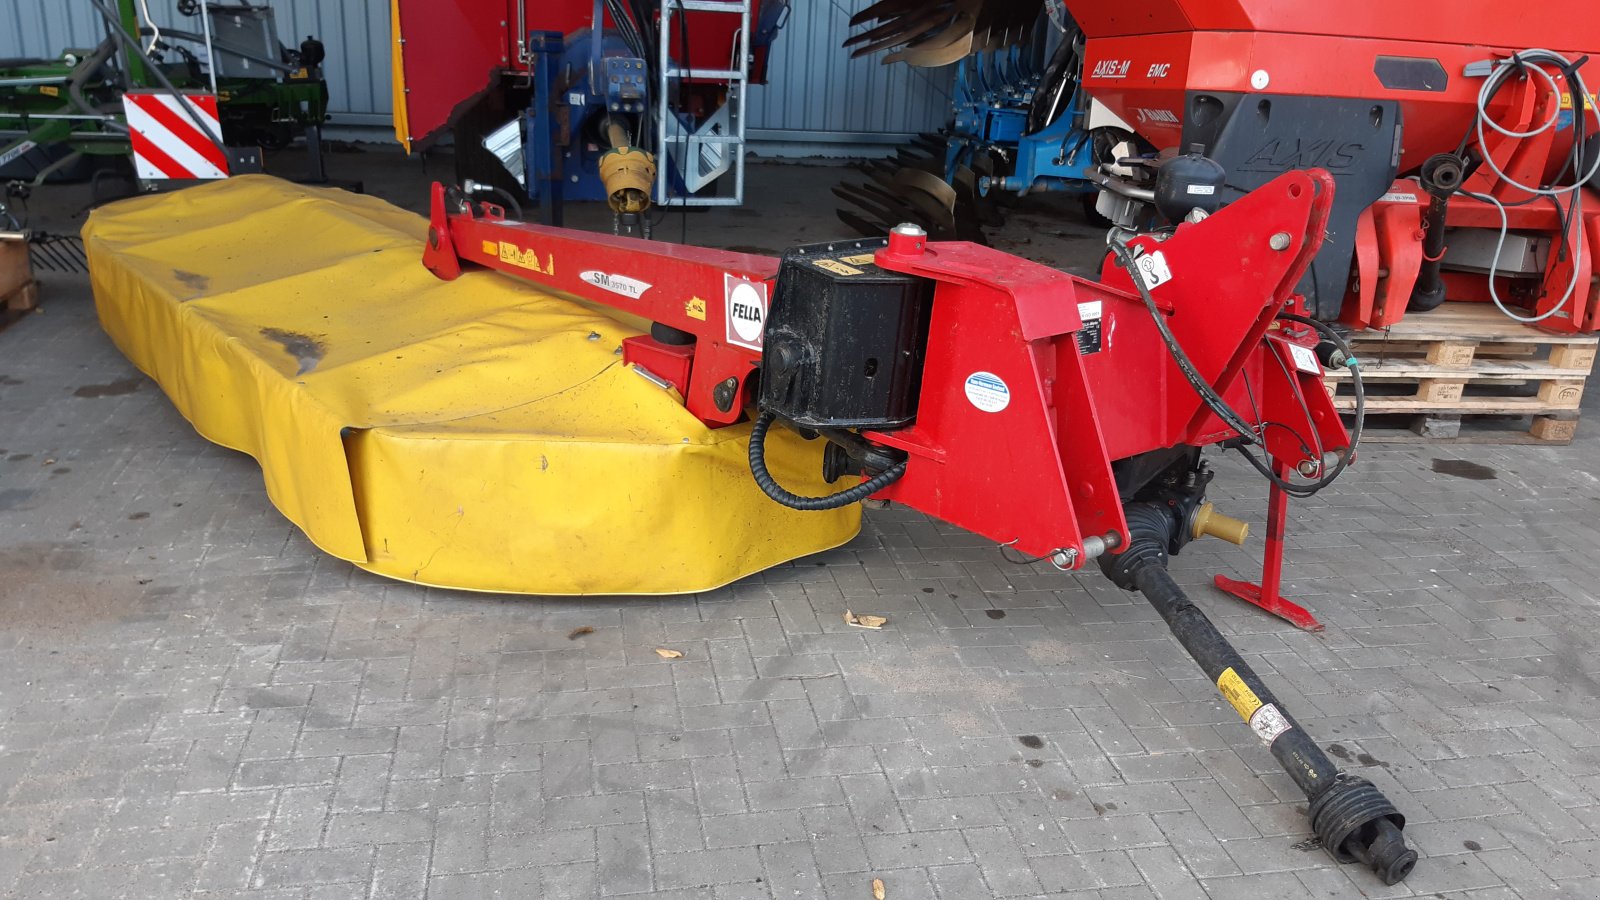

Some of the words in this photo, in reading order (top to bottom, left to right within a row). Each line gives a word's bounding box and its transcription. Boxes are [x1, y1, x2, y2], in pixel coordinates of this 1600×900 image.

[1092, 60, 1131, 76] AXIS-M
[1146, 63, 1170, 78] EMC
[1244, 137, 1364, 170] AXIS
[593, 272, 610, 287] SM
[629, 285, 638, 295] TL
[732, 302, 762, 323] FELLA
